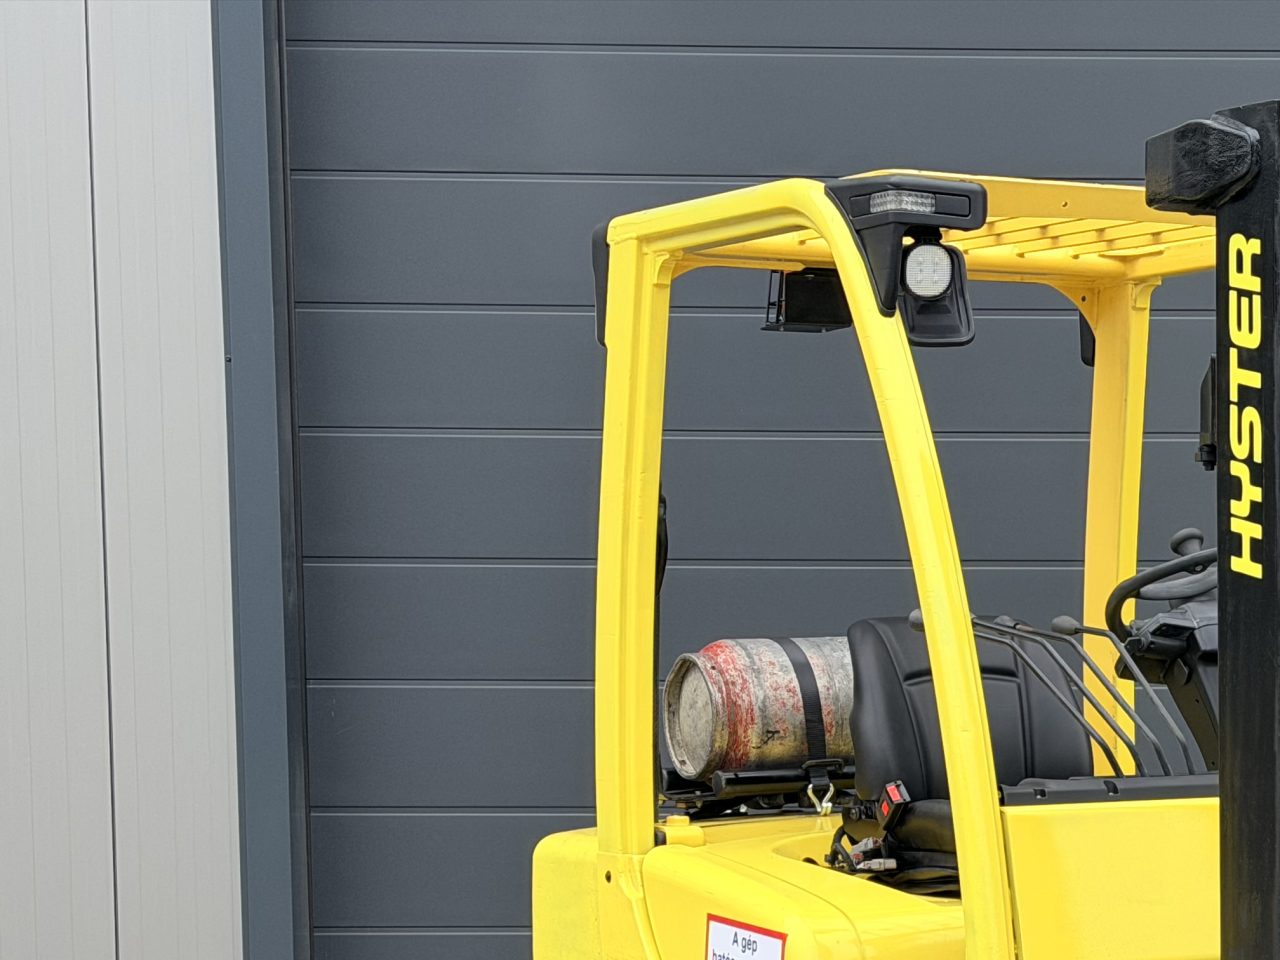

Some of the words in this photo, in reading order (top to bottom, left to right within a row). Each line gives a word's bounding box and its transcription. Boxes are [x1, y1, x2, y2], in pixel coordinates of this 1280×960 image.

[1229, 233, 1262, 579] HYSTER
[732, 931, 739, 947] A
[741, 934, 757, 955] gép
